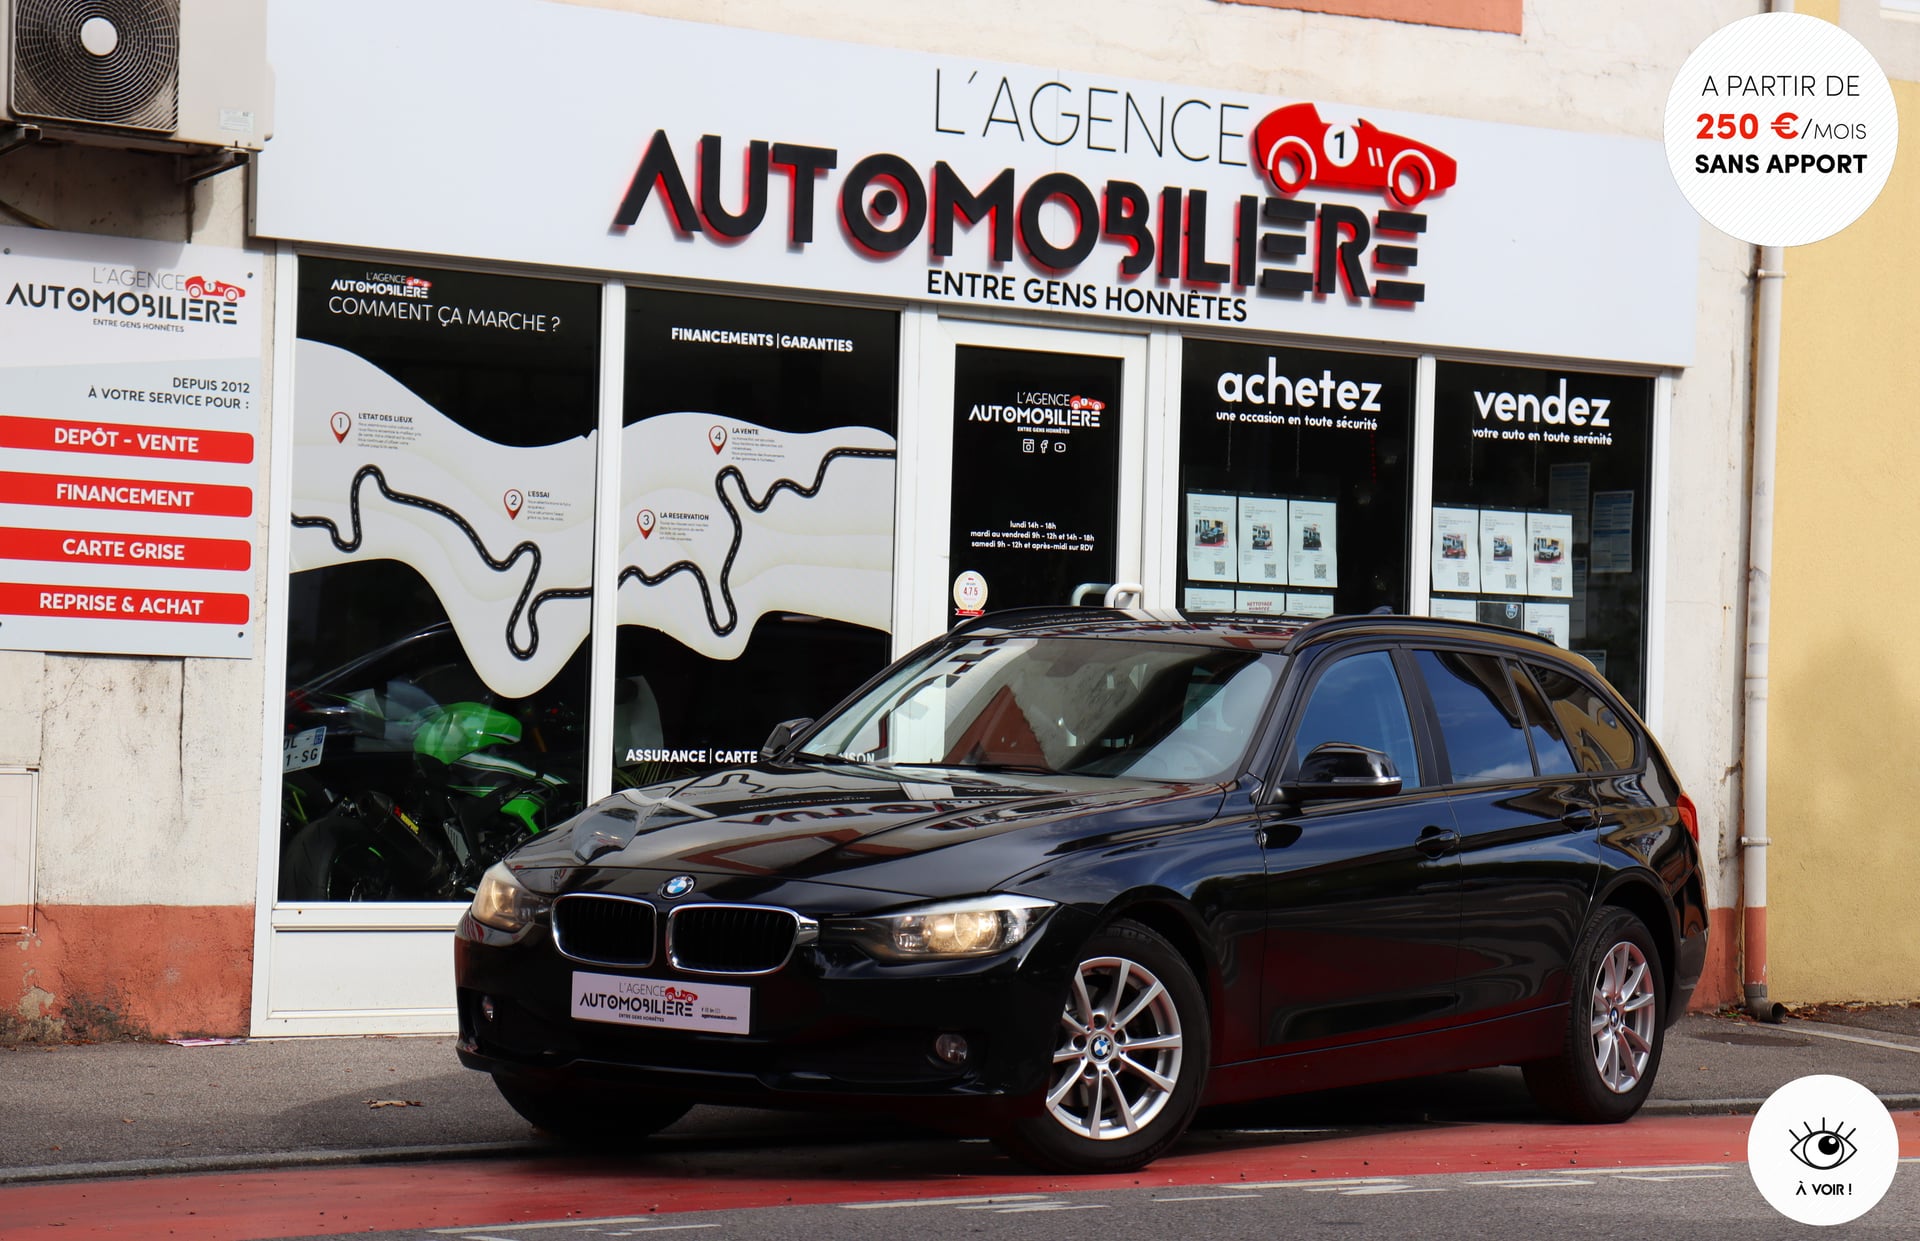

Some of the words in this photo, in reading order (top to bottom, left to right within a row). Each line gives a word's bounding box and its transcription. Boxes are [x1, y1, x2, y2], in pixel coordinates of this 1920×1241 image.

[936, 68, 1249, 167] L'AGENCE
[612, 129, 1428, 304] AUTOMOBILIERE
[92, 267, 185, 292] L'AGENCE
[6, 282, 238, 325] AUTOMOBILIERE
[928, 269, 1015, 301] ENTRE
[1023, 278, 1097, 309] GENS
[1105, 286, 1248, 323] HONNÊTES
[93, 318, 118, 328] ENTRE
[119, 320, 141, 330] GENS
[143, 322, 185, 333] HONNÊTES
[328, 296, 433, 322] COMMENT
[437, 306, 463, 327] ÇA
[467, 309, 546, 332] MARCHE
[551, 316, 561, 333] ?
[671, 327, 774, 347] FINANCEMENTS
[781, 335, 854, 352] GARANTIES
[173, 377, 218, 391] DEPUIS
[220, 380, 251, 394] 2012
[1217, 356, 1382, 412] achetez
[88, 385, 97, 399] À
[101, 388, 145, 402] VOTRE
[149, 391, 202, 406] SERVICE
[205, 394, 241, 410] POUR
[1474, 378, 1611, 427] vendez
[380, 414, 393, 422] DES
[394, 415, 413, 423] LIEUX
[1216, 411, 1236, 422] une
[1239, 411, 1285, 425] occasion
[1288, 416, 1301, 426] en
[1304, 415, 1333, 428] toute
[1336, 416, 1378, 431] sécurité
[54, 427, 119, 448] DEPÔT
[137, 433, 199, 453] VENTE
[1472, 428, 1499, 440] votre
[1502, 429, 1525, 441] auto
[1528, 432, 1541, 442] en
[1543, 431, 1570, 443] toute
[1573, 431, 1613, 446] serénité
[56, 483, 194, 507] FINANCEMENT
[510, 494, 517, 506] 2
[643, 514, 650, 526] 3
[668, 512, 710, 521] RESERVATION
[1009, 520, 1027, 529] lundi
[1027, 521, 1039, 529] 14h
[1045, 522, 1057, 530] 18h
[971, 540, 996, 548] samedi
[1011, 541, 1023, 549] 12h
[1031, 542, 1068, 551] après-midi
[1080, 543, 1094, 552] RDV
[1001, 530, 1031, 539] vendredi
[1031, 531, 1040, 539] 9h
[1046, 532, 1058, 540] 12h
[1066, 533, 1078, 541] 14h
[1083, 534, 1095, 542] 18h
[62, 538, 125, 558] CARTE
[129, 542, 185, 561] GRISE
[39, 592, 117, 612] REPRISE
[121, 596, 135, 613] &
[140, 597, 204, 616] ACHAT
[625, 748, 706, 763] ASSURANCE
[714, 750, 758, 764] CARTE
